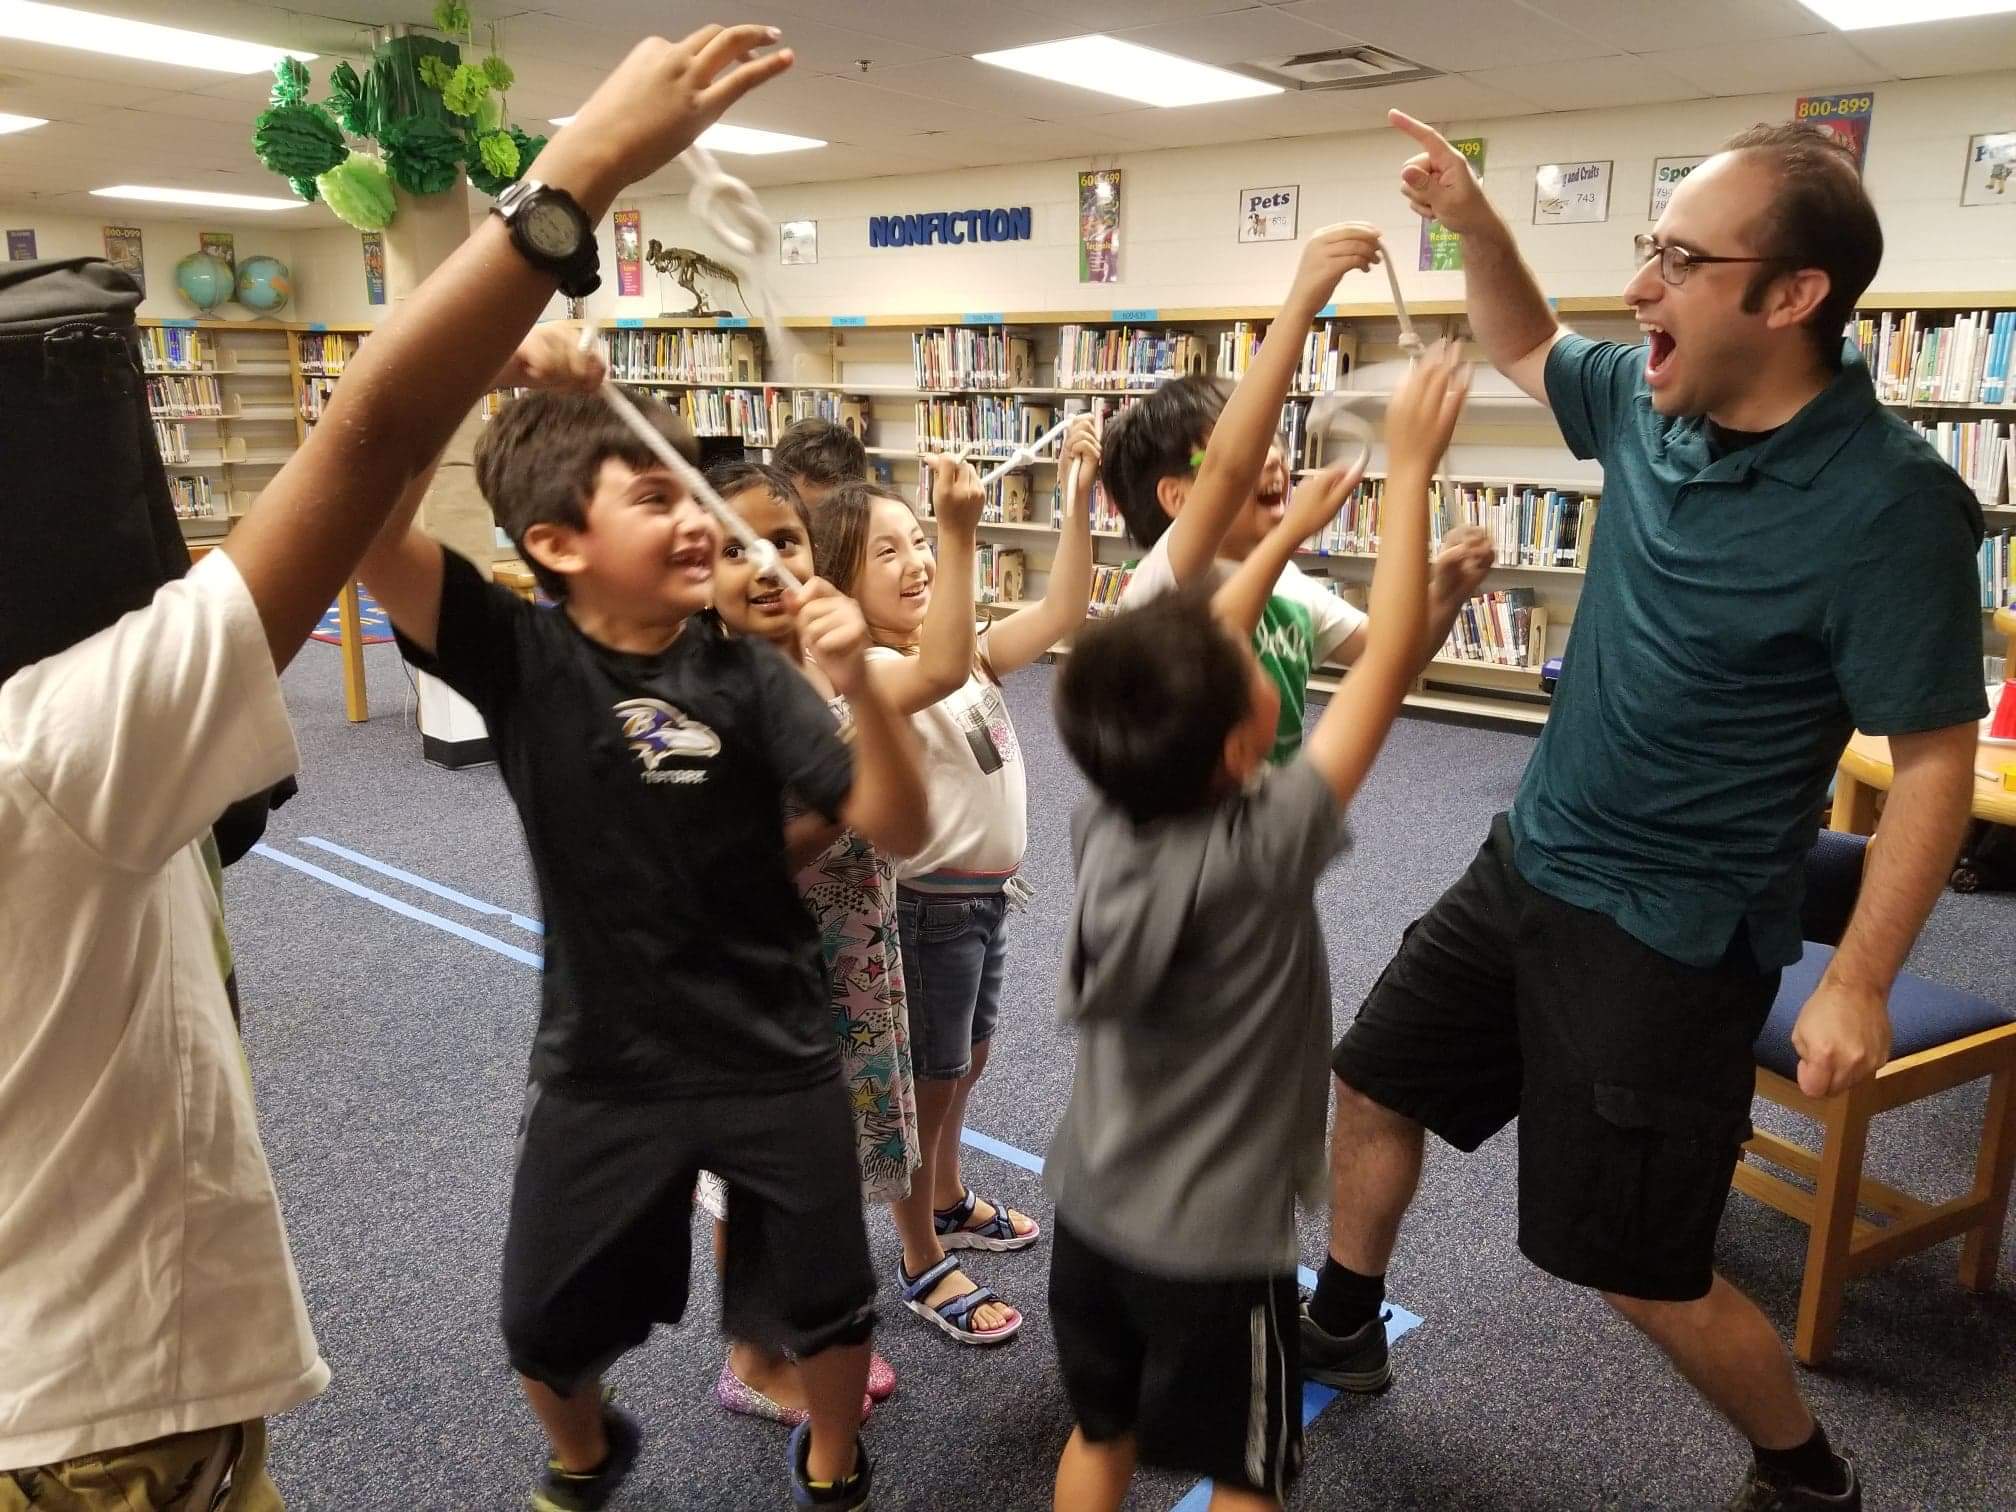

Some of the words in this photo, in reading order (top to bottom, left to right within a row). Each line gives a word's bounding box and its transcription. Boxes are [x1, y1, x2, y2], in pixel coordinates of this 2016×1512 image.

[1798, 98, 1870, 117] 800-899
[1658, 165, 1699, 182] Spo
[1249, 193, 1290, 212] Pets
[1577, 193, 1595, 203] 743
[869, 206, 1031, 248] NONFICTION
